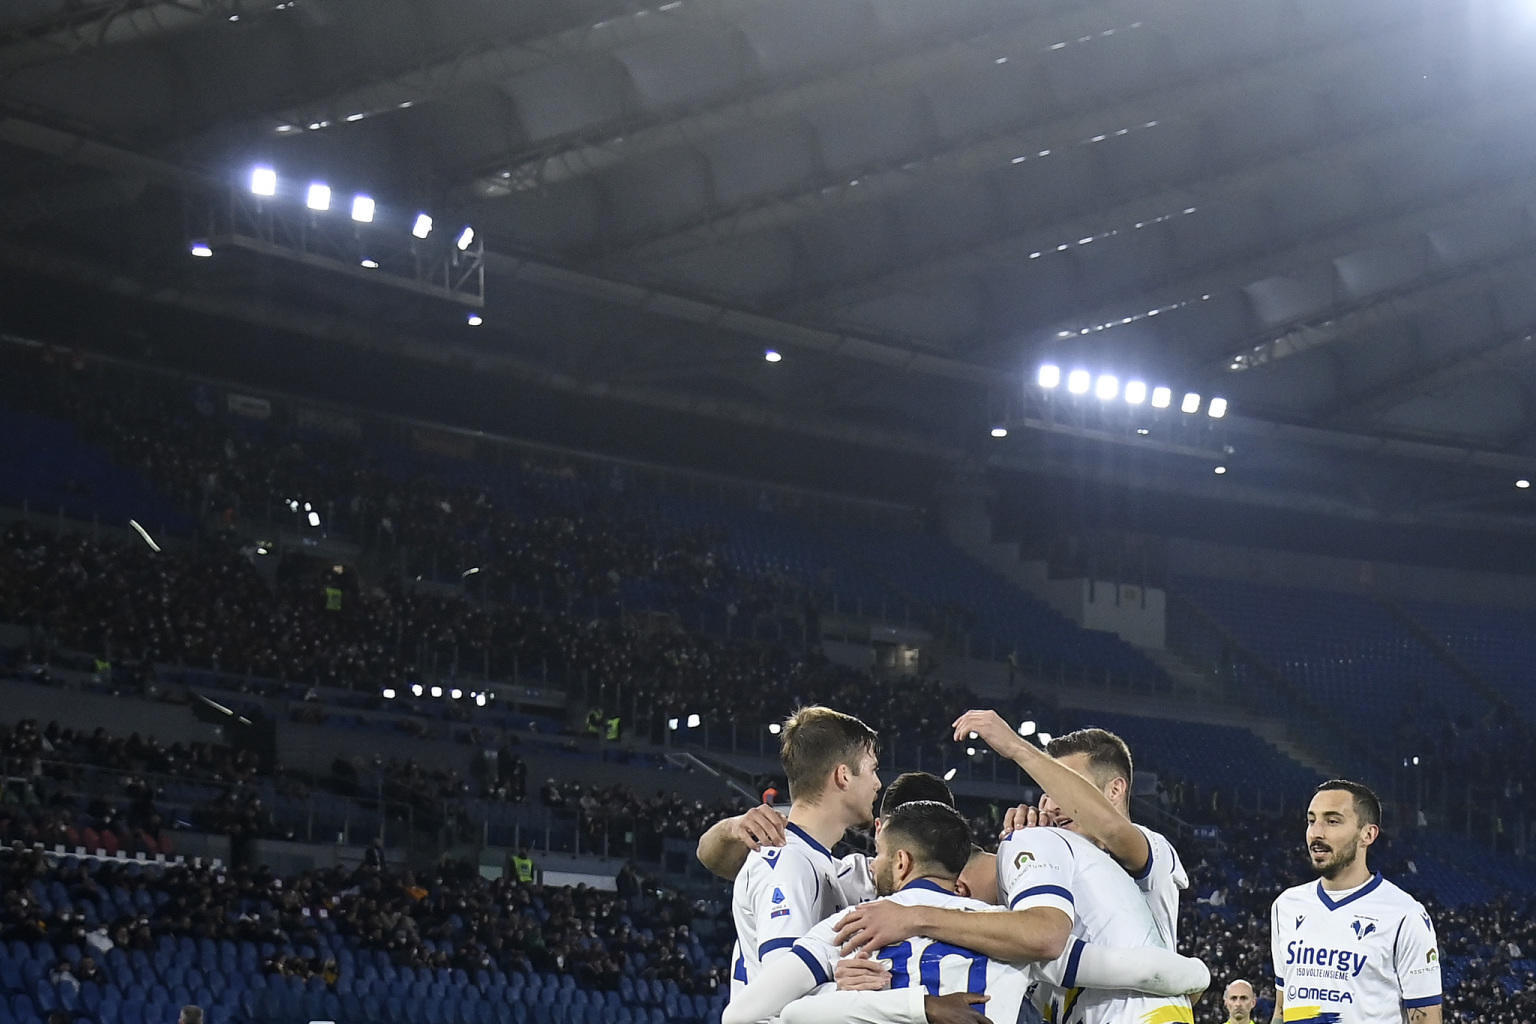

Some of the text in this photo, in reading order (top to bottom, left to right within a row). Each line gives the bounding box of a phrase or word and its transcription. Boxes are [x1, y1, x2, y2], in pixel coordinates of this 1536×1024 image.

[1286, 939, 1367, 977] Sinergy
[1296, 967, 1306, 977] 150
[1297, 987, 1353, 1004] OMEGA
